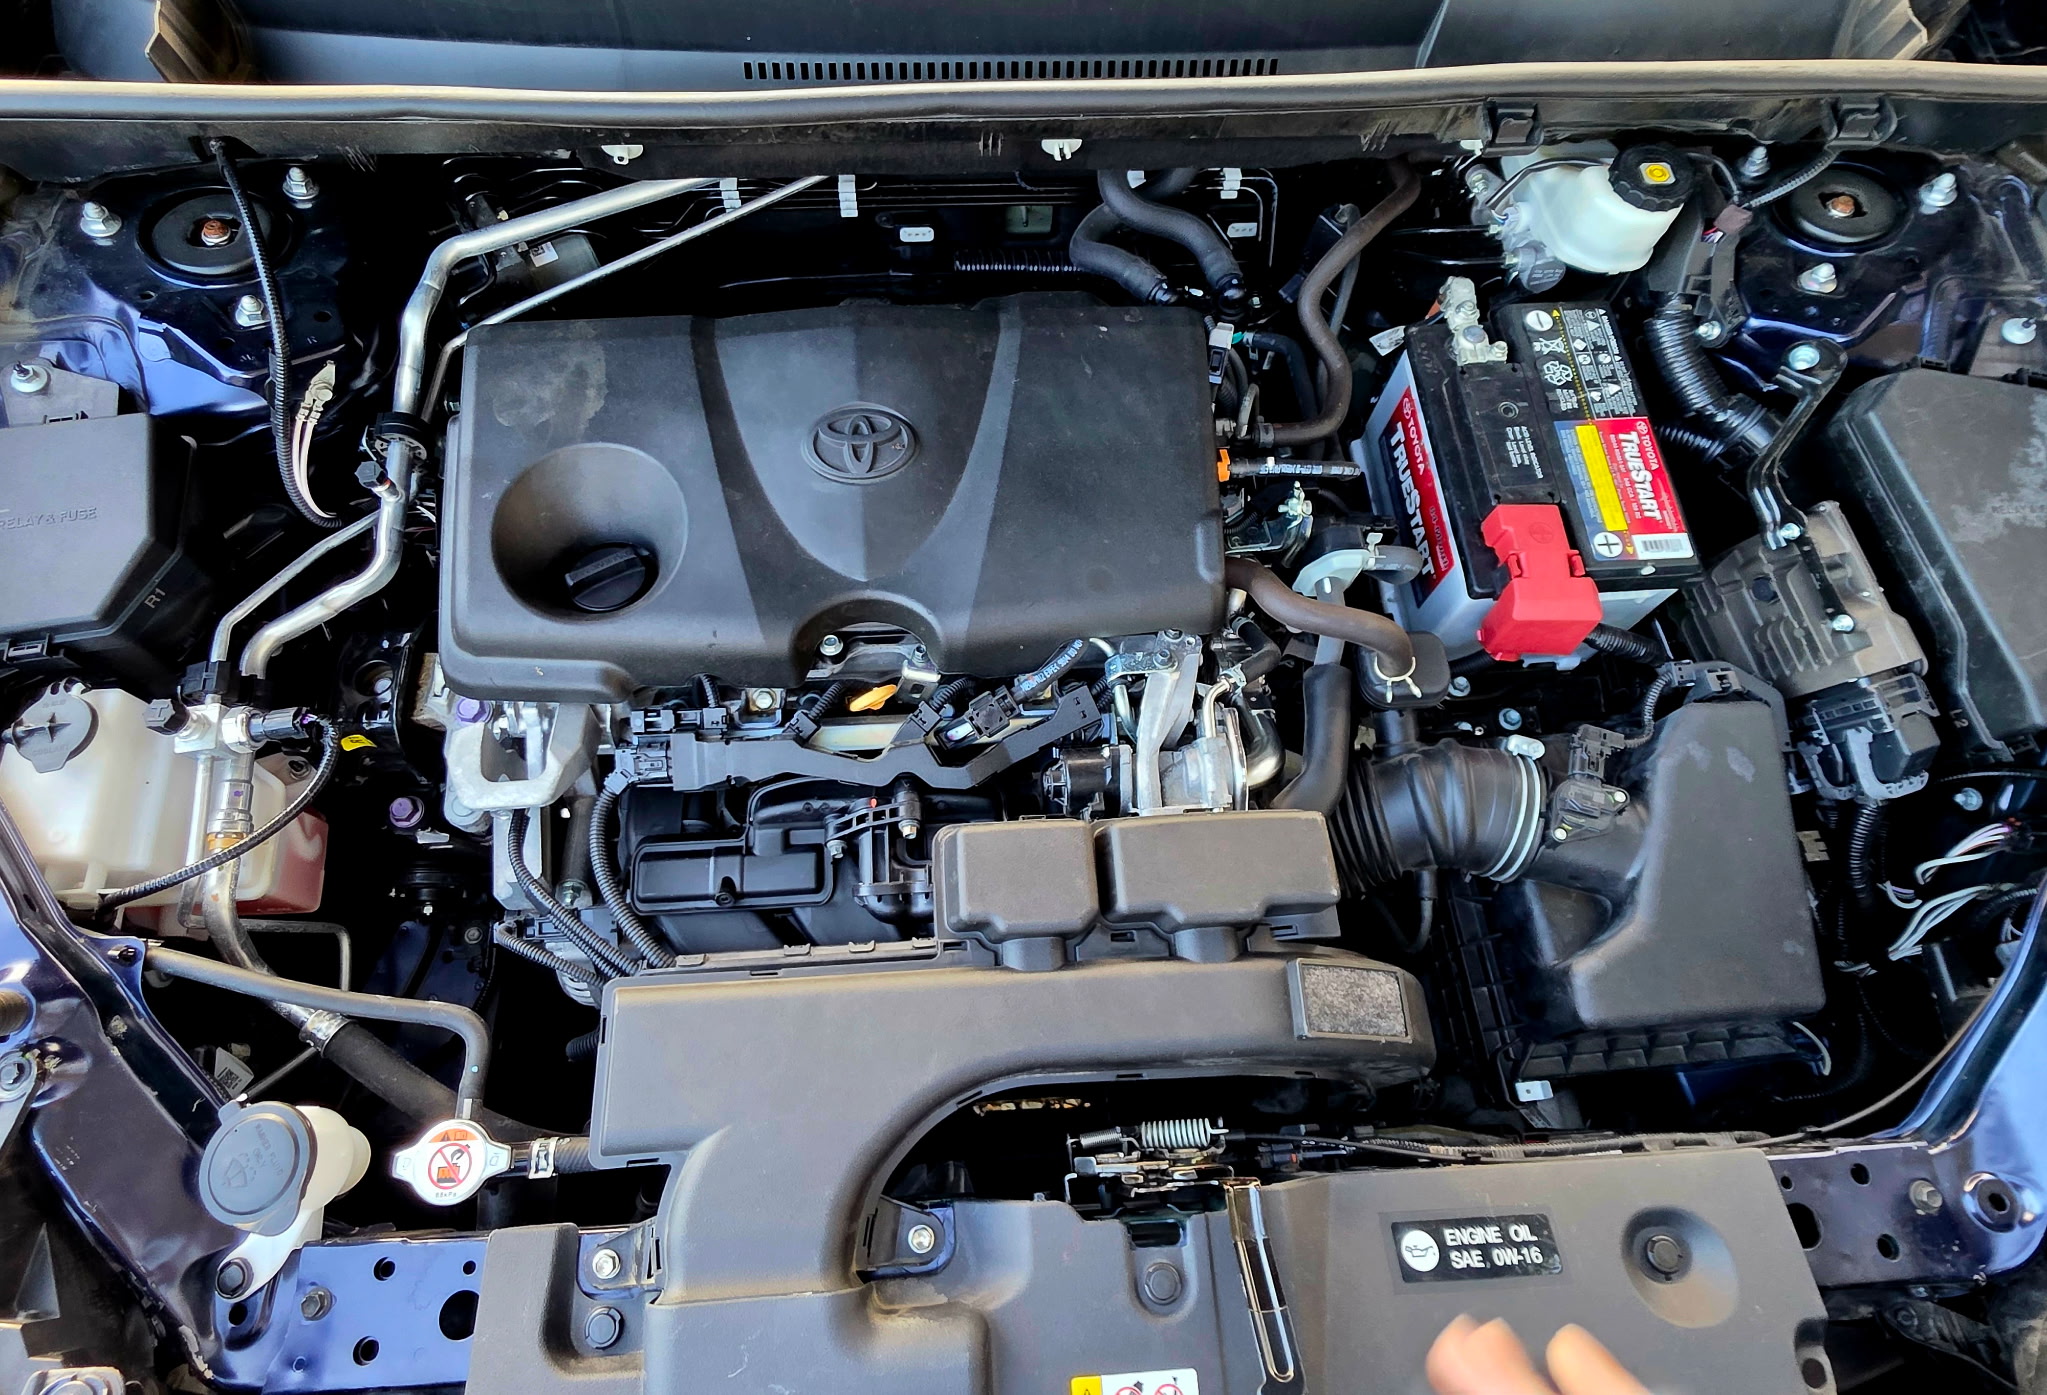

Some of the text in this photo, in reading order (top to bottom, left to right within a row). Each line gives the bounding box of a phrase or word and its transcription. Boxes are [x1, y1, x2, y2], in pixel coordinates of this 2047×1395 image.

[1407, 421, 1424, 476] TOYOTA
[1641, 435, 1660, 470] TOYOTA
[60, 508, 98, 523] FUSE
[144, 588, 166, 608] R1
[1949, 708, 1969, 728] L2
[1443, 1223, 1539, 1246] ENGINE OIL
[1449, 1247, 1544, 1269] SAE 0W-16
